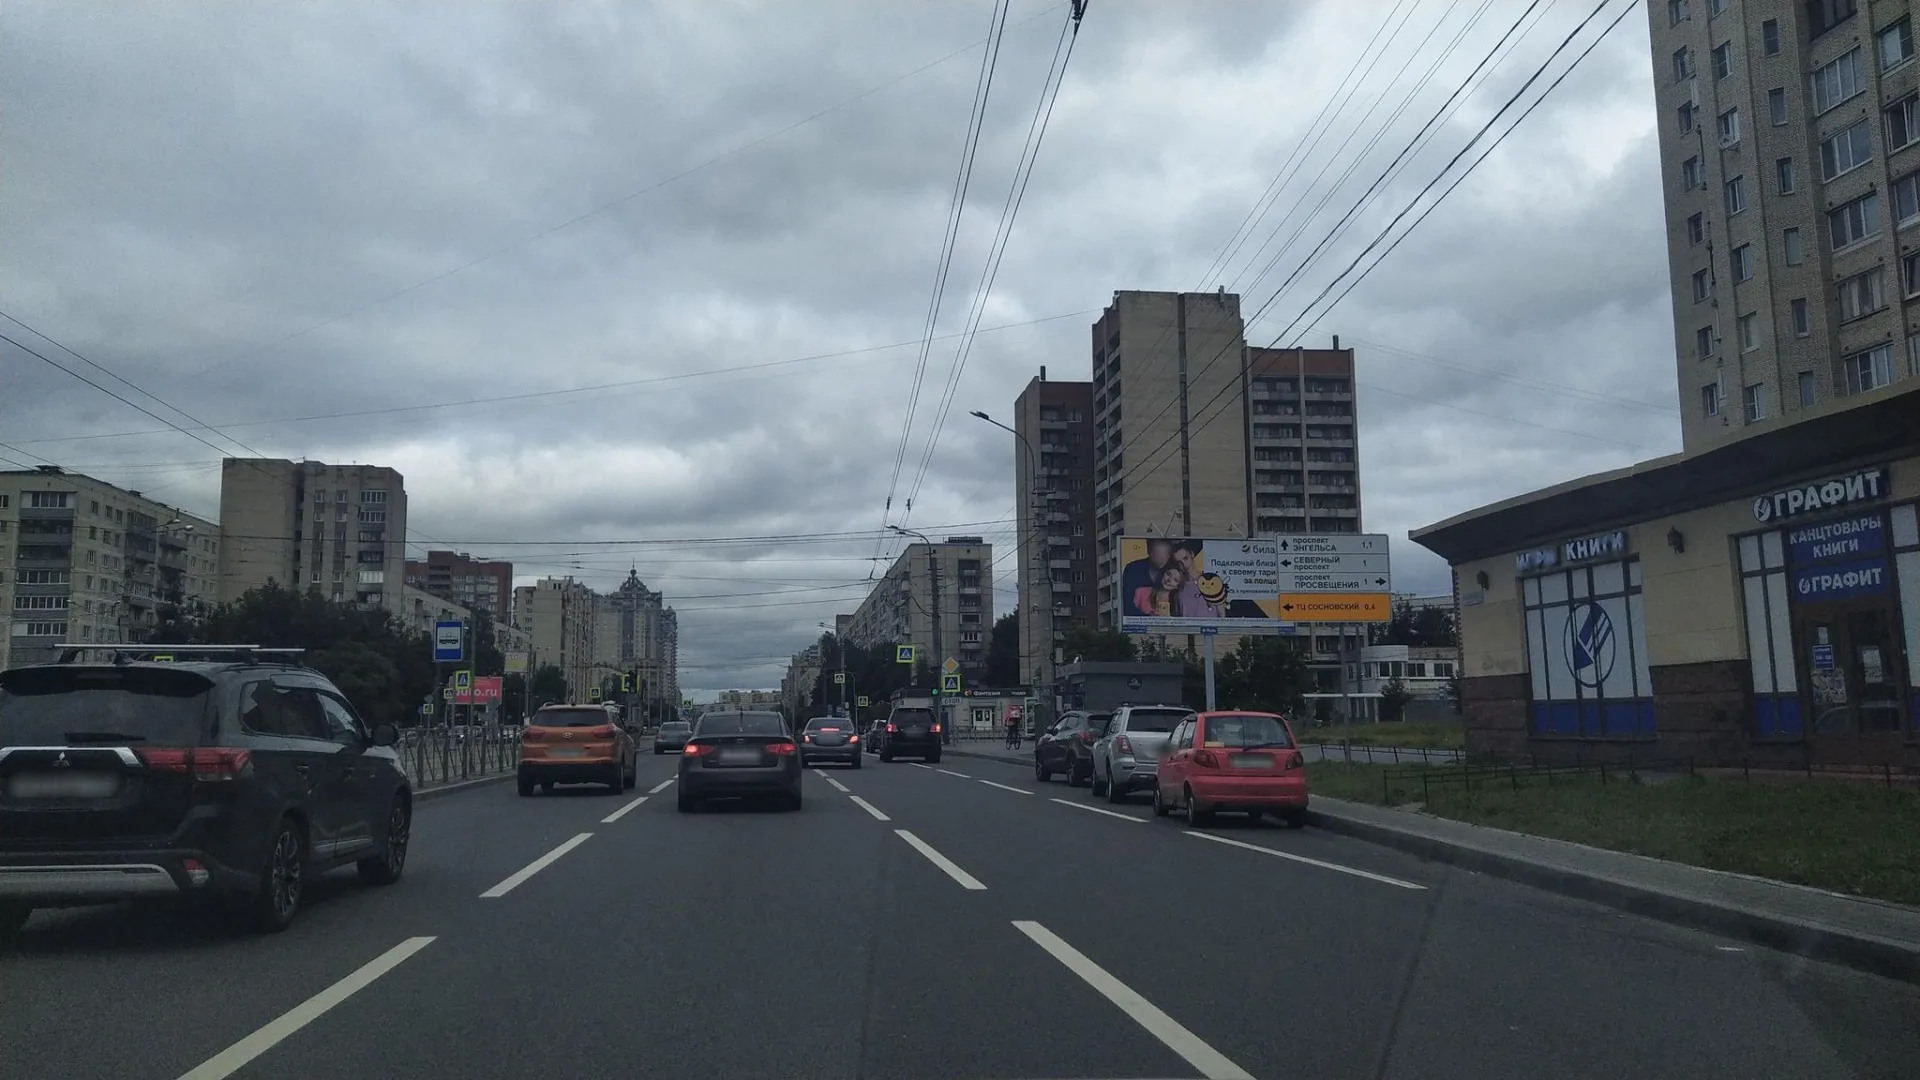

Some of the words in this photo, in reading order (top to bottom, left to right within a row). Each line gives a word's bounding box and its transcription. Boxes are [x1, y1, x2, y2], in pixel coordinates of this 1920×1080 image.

[1774, 471, 1880, 516] ГРАФИТ
[1789, 514, 1881, 544] КАНЦТОВАРЫ
[1293, 537, 1329, 545] проспект
[1362, 541, 1372, 549] 1,1
[1566, 532, 1624, 560] КНИГИ
[1813, 538, 1859, 558] КНИГИ
[1211, 559, 1254, 567] Подключай
[1294, 556, 1340, 564] СЕВЕРНЫЙ
[1294, 574, 1330, 582] проспект
[1364, 578, 1368, 586] 1
[1812, 568, 1882, 592] ГРАФИТ
